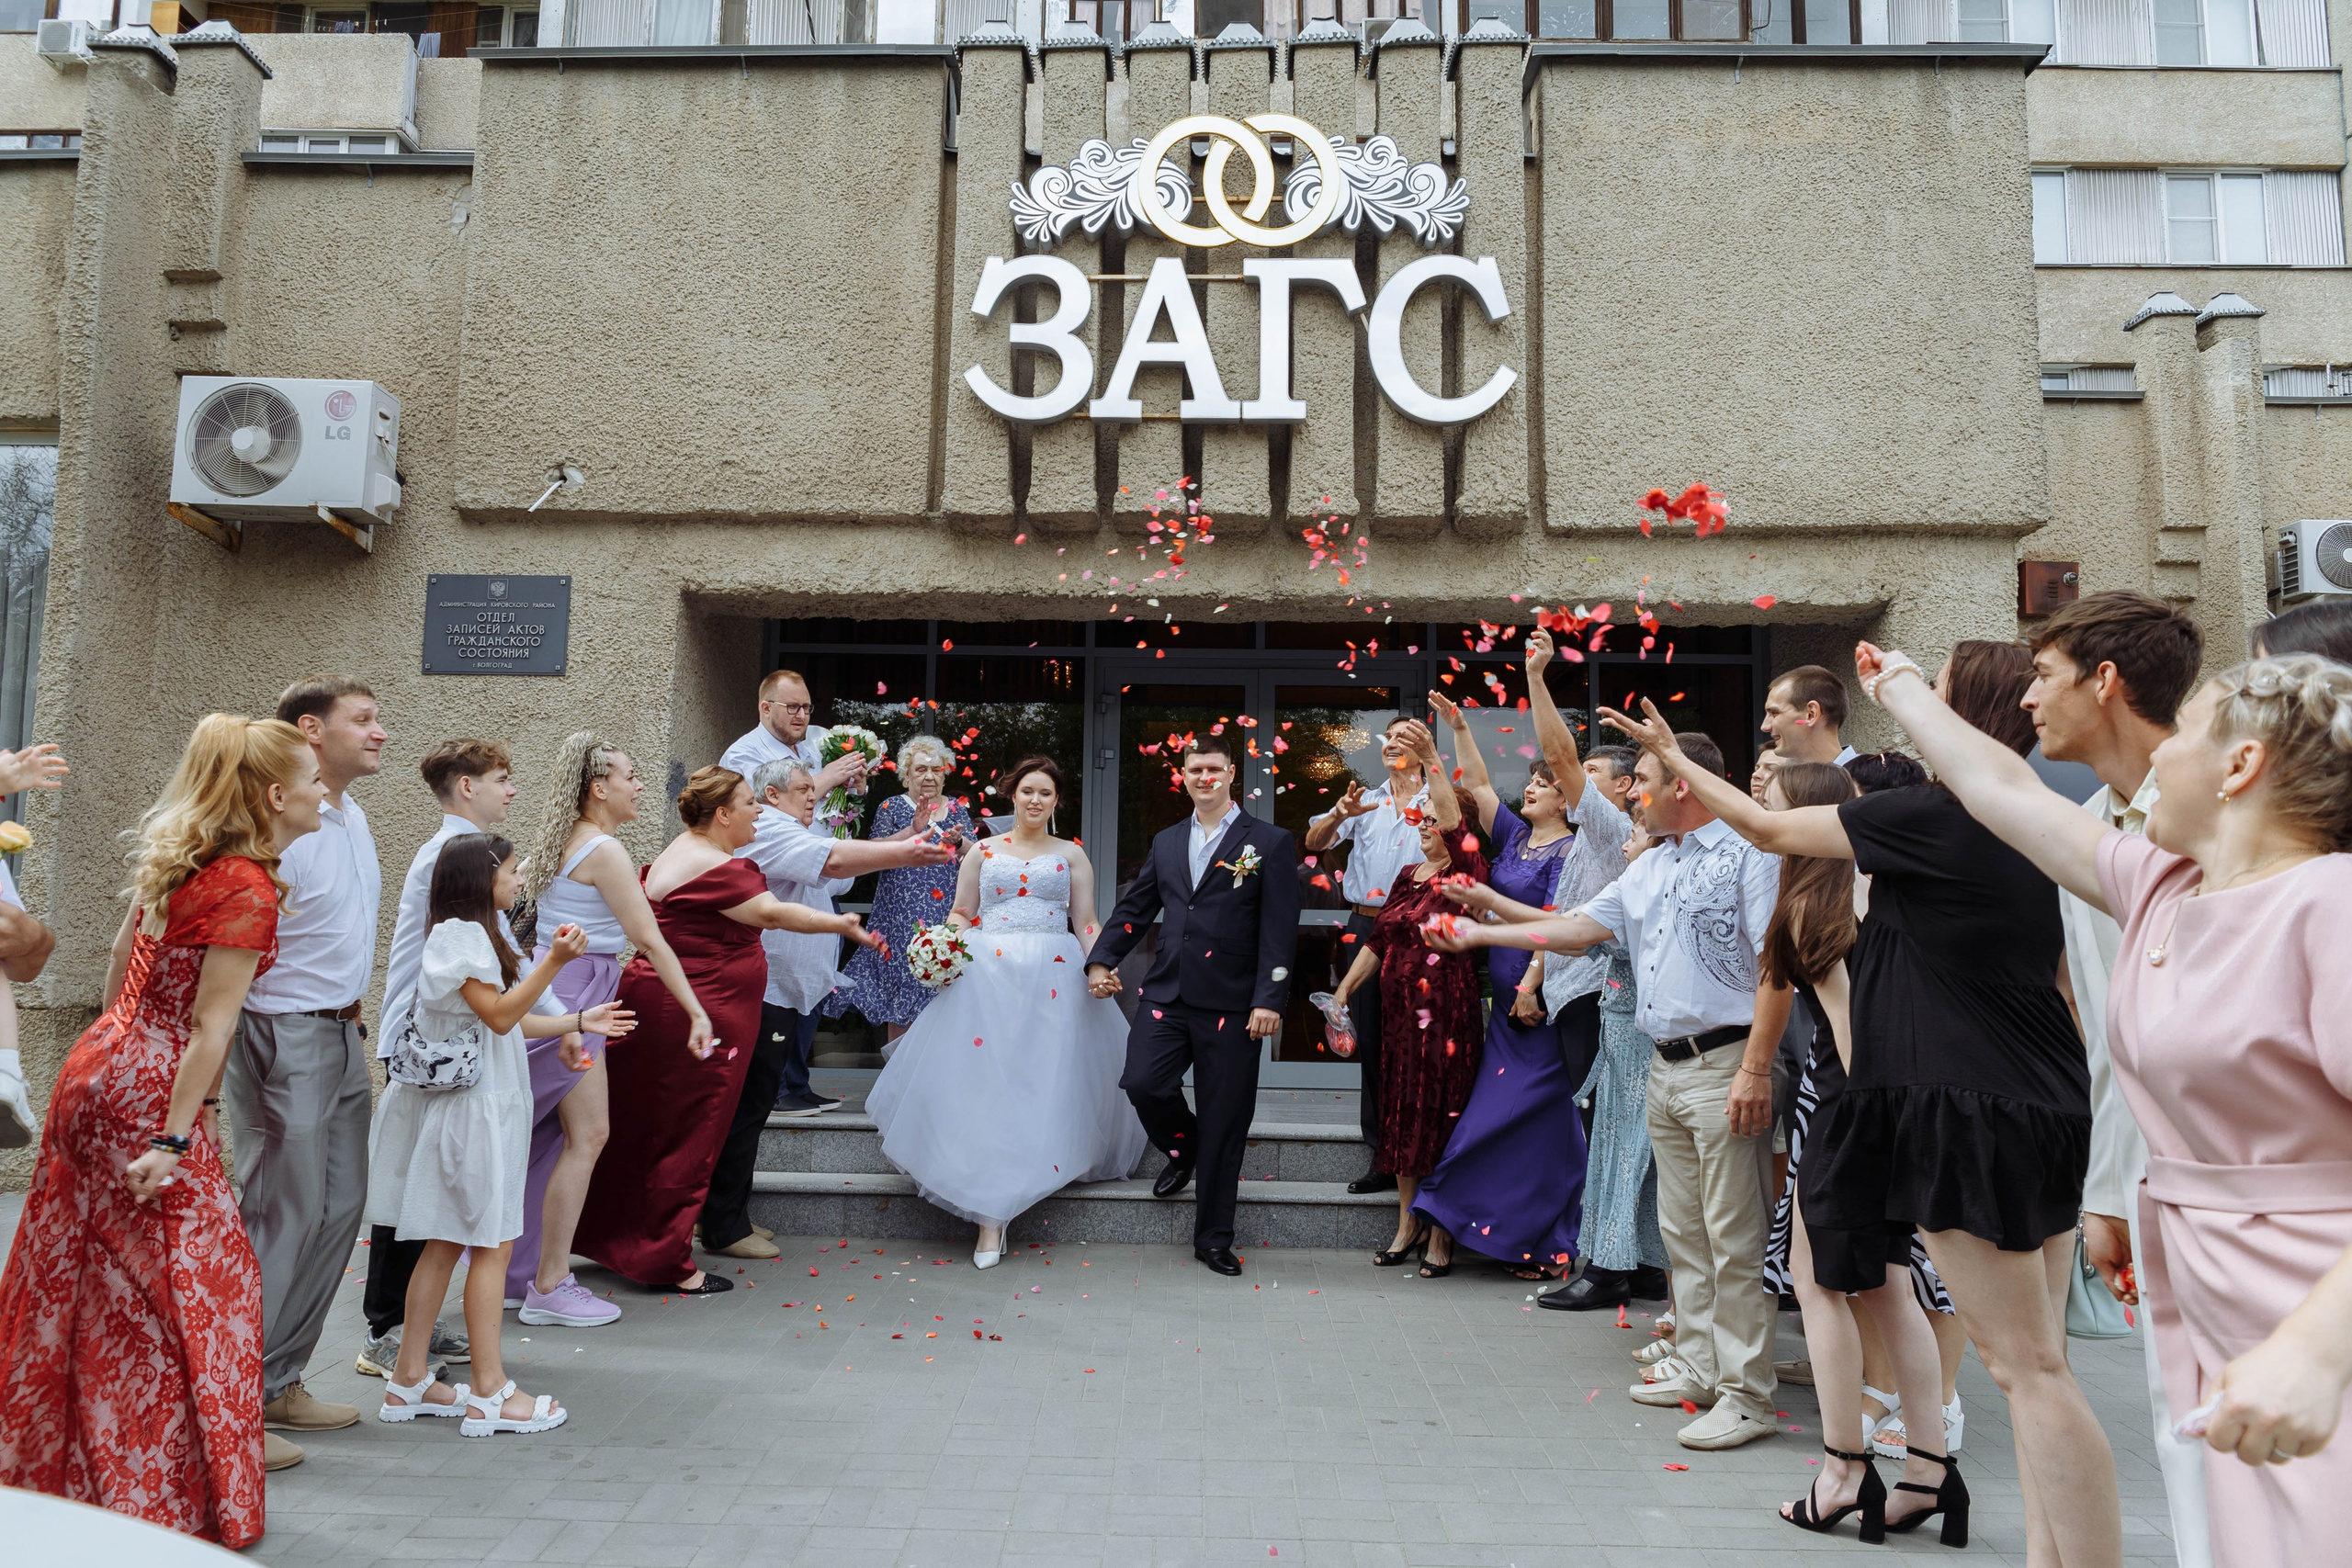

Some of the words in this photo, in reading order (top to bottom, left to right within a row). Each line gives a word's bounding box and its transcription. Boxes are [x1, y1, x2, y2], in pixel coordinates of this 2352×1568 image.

[963, 254, 1519, 427] ЗАГС
[324, 425, 351, 441] LG
[476, 612, 515, 624] ОТДЕЛ
[446, 623, 501, 635] ЗАПИСЕЙ
[507, 625, 545, 635] АКТОВ
[447, 636, 541, 648] ГРАЖДАНСКОГО
[458, 648, 529, 659] СОСТОЯНИЯ
[477, 661, 513, 670] ВОЛГОГРАД
